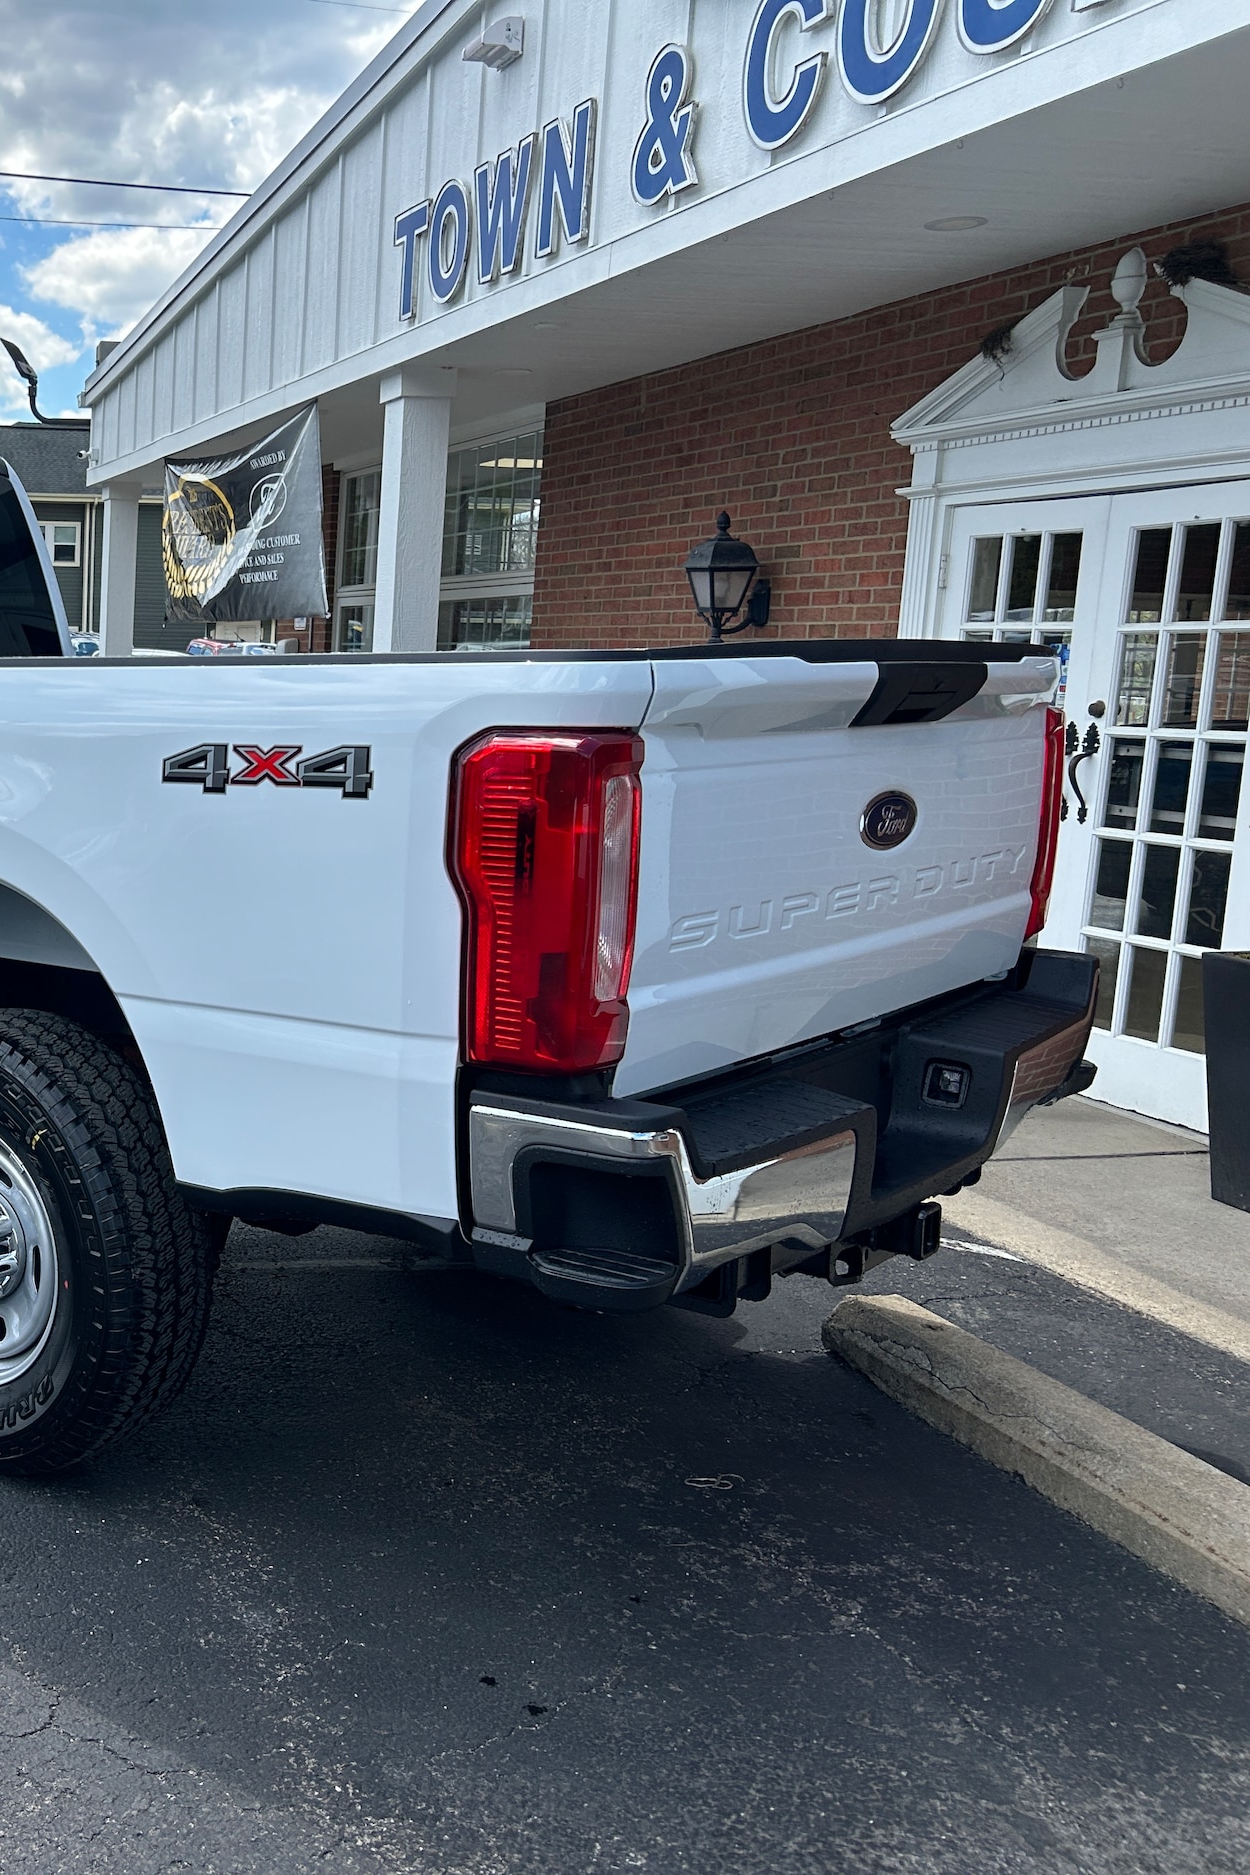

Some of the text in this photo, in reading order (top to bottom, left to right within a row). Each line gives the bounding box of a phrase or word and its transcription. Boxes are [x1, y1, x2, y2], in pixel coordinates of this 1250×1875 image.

[393, 97, 597, 323] TOWN
[631, 43, 699, 206] &
[277, 449, 287, 462] BY
[266, 533, 301, 549] CUSTOMER
[254, 555, 267, 567] AND
[266, 552, 285, 565] SALES
[238, 570, 279, 585] PERFORMANCE
[161, 742, 374, 800] 4X4
[875, 803, 910, 838] Ford
[669, 845, 1027, 954] SUPER DUTY
